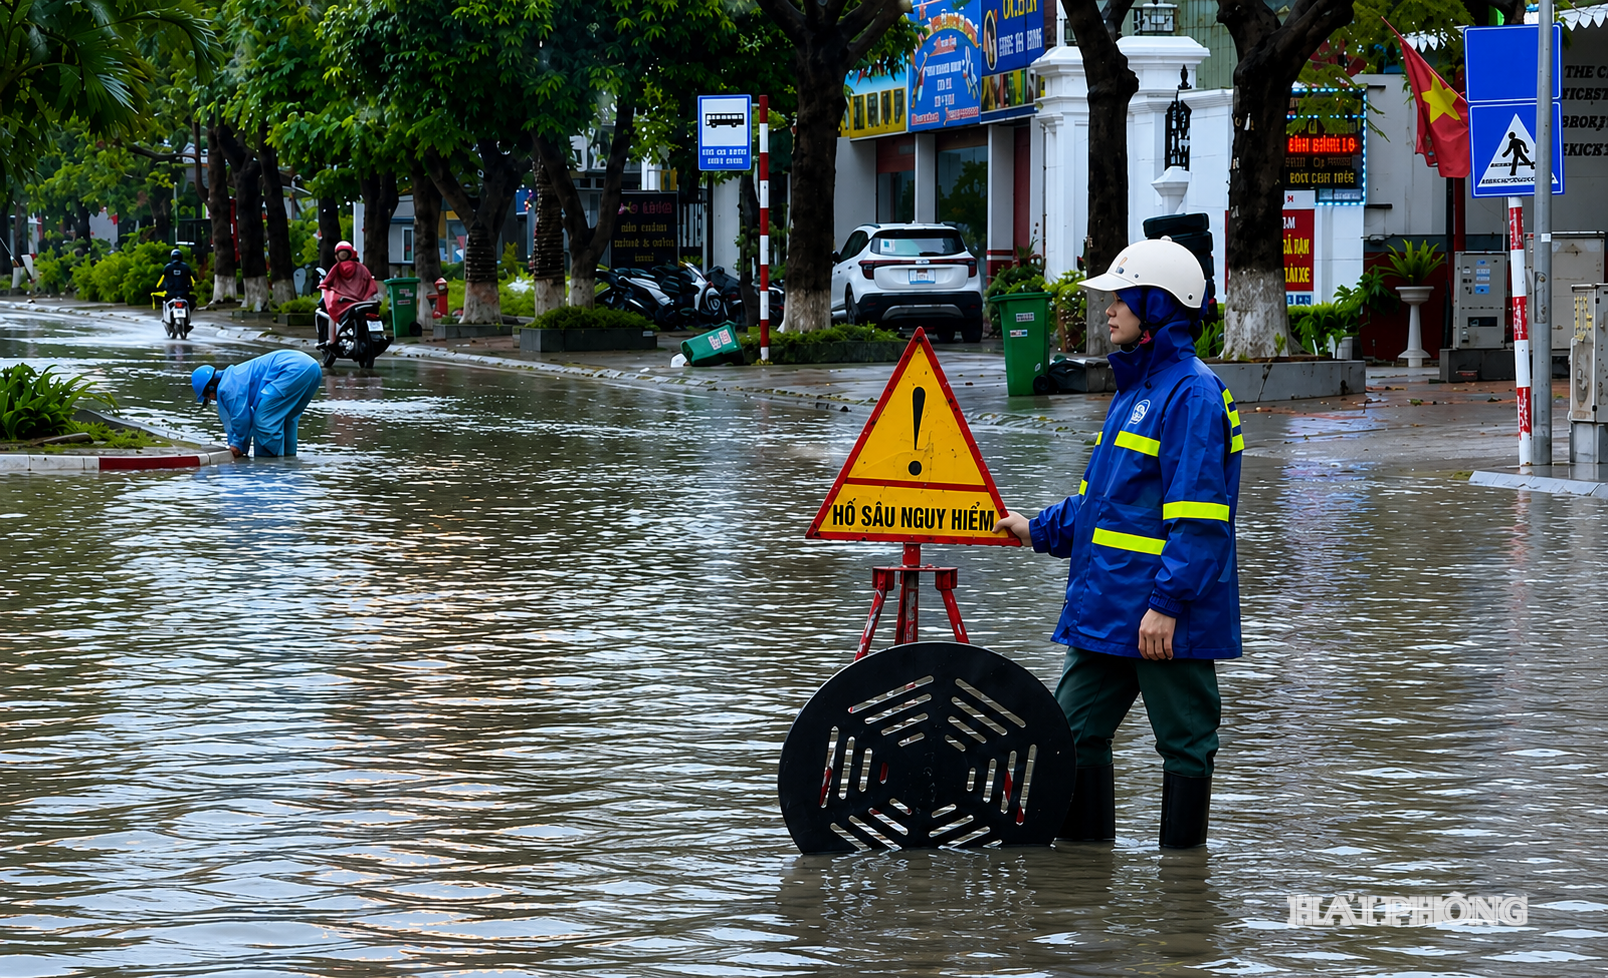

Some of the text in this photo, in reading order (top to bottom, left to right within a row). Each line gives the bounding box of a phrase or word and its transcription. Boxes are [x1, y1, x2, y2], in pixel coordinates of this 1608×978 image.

[832, 497, 995, 532] HỐ SÂU NGUY HIỂM
